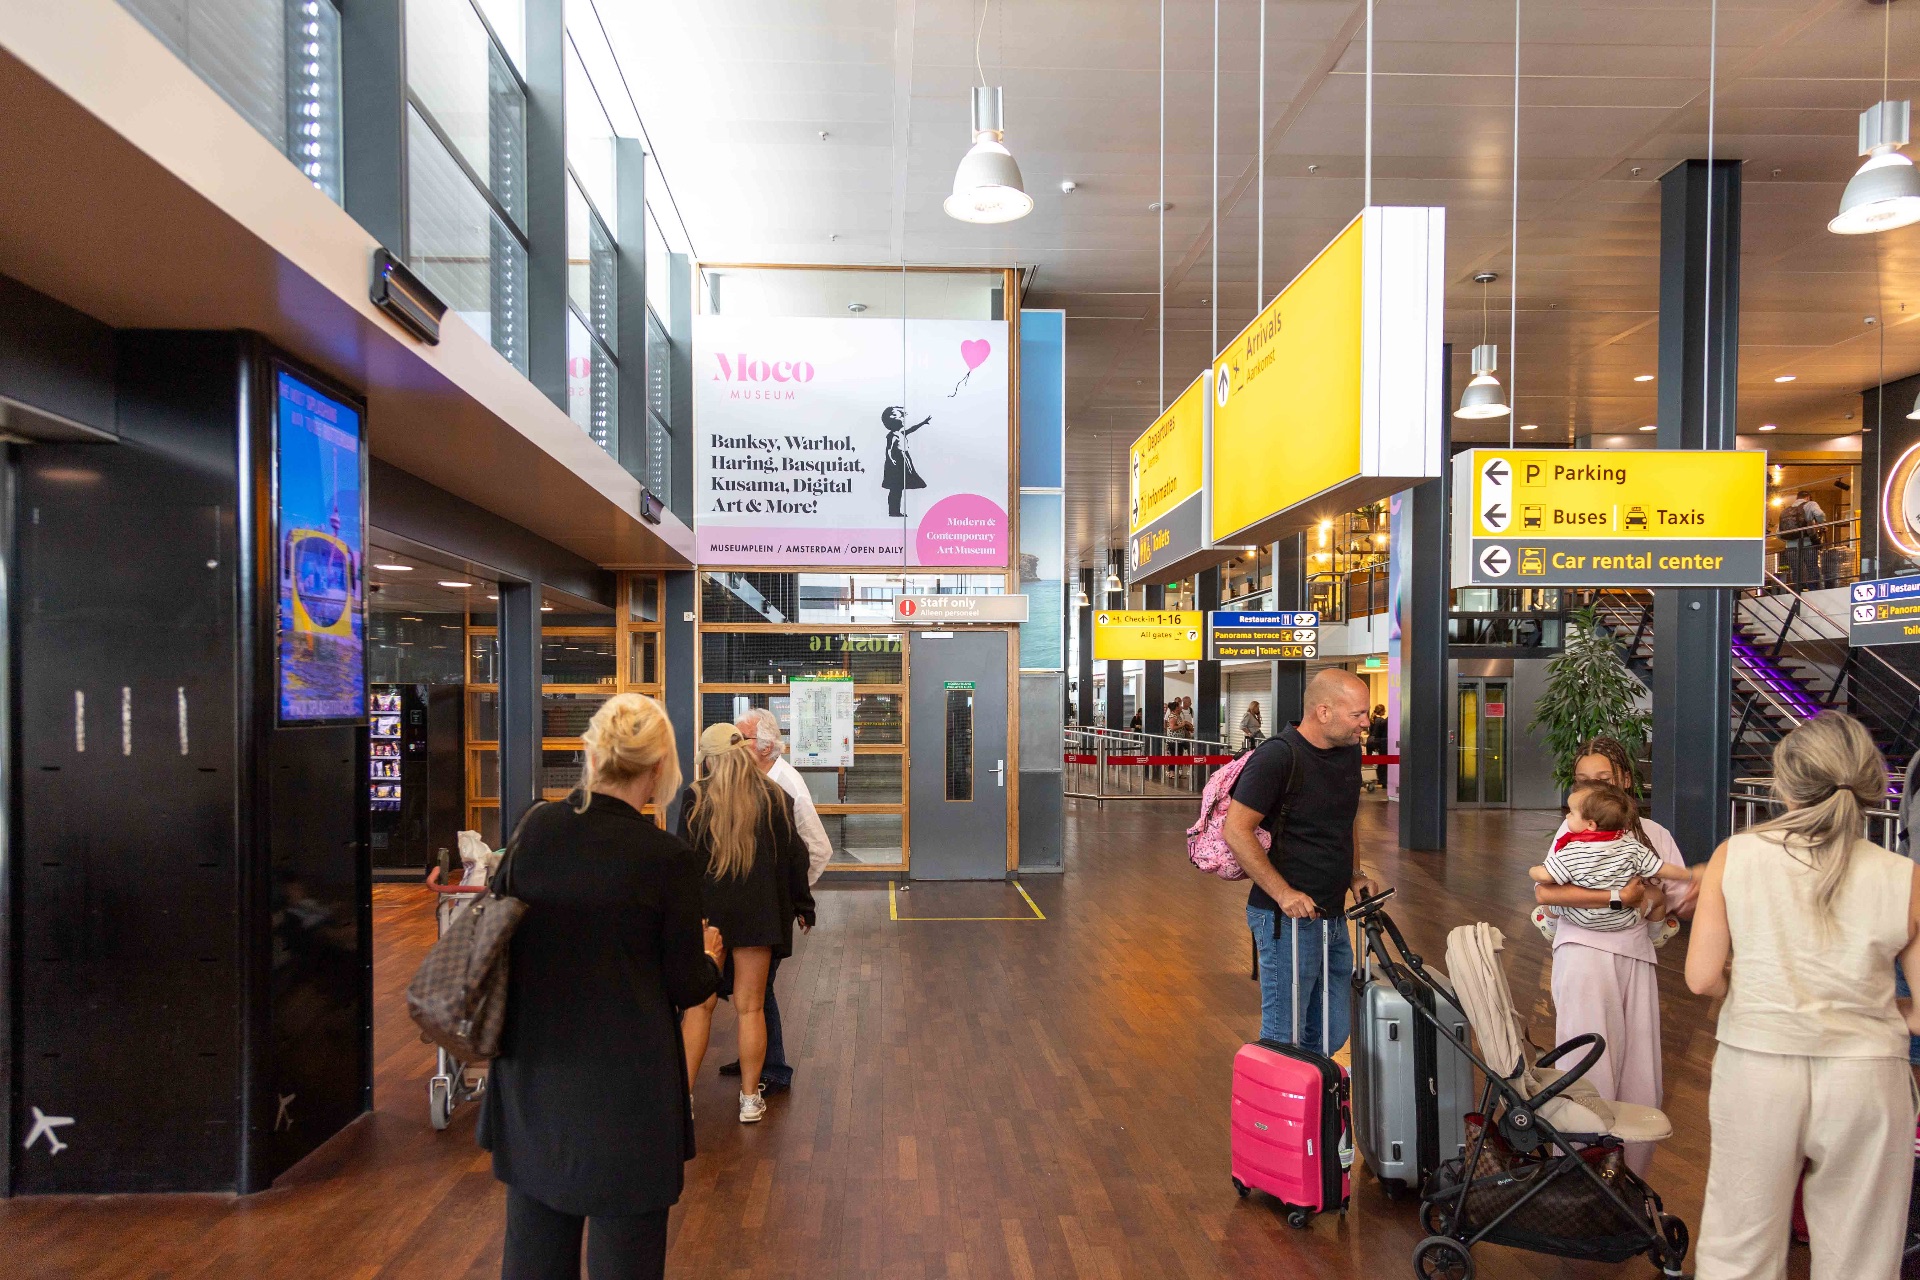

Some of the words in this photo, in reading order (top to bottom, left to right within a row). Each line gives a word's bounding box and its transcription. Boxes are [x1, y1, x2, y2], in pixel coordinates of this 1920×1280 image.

[1246, 309, 1282, 361] Arrivals
[712, 353, 815, 382] Moco
[1246, 347, 1275, 384] Aankomst
[730, 390, 795, 400] MUSEUM
[1147, 415, 1176, 452] Departures
[711, 434, 781, 453] Banksy,
[784, 436, 856, 452] Warhol,
[711, 455, 779, 474] Haring,
[782, 457, 865, 475] Basquiat,
[1554, 464, 1627, 485] Parking
[711, 476, 790, 494] Kusama,
[793, 477, 853, 496] Digital
[1147, 476, 1177, 507] Information
[712, 497, 743, 513] Art
[745, 499, 762, 513] &
[766, 499, 818, 514] More!
[947, 518, 985, 526] Modern
[987, 518, 996, 526] &
[1553, 509, 1607, 525] Buses
[1657, 509, 1705, 525] Taxis
[926, 531, 996, 542] Contemporary
[1152, 528, 1170, 552] Toilets
[710, 544, 774, 553] MUSEUMPLEIN
[786, 545, 841, 554] AMSTERDAM
[850, 546, 875, 554] OPEN
[878, 546, 904, 554] DAILY
[937, 546, 953, 554] Art
[955, 546, 996, 554] Museum
[1552, 552, 1586, 570] Car
[1592, 551, 1652, 570] rental
[1658, 554, 1723, 570] center
[920, 598, 949, 608] Staff
[951, 598, 976, 610] only
[944, 609, 980, 617] personeel
[1124, 615, 1155, 623] Check-in
[1157, 614, 1181, 625] 1-16
[1239, 615, 1280, 623] Restaurant
[1152, 632, 1172, 640] gates
[1215, 631, 1252, 639] Panorama
[1253, 631, 1280, 639] terrace
[1220, 647, 1239, 656] Baby
[1260, 647, 1281, 655] Toilet
